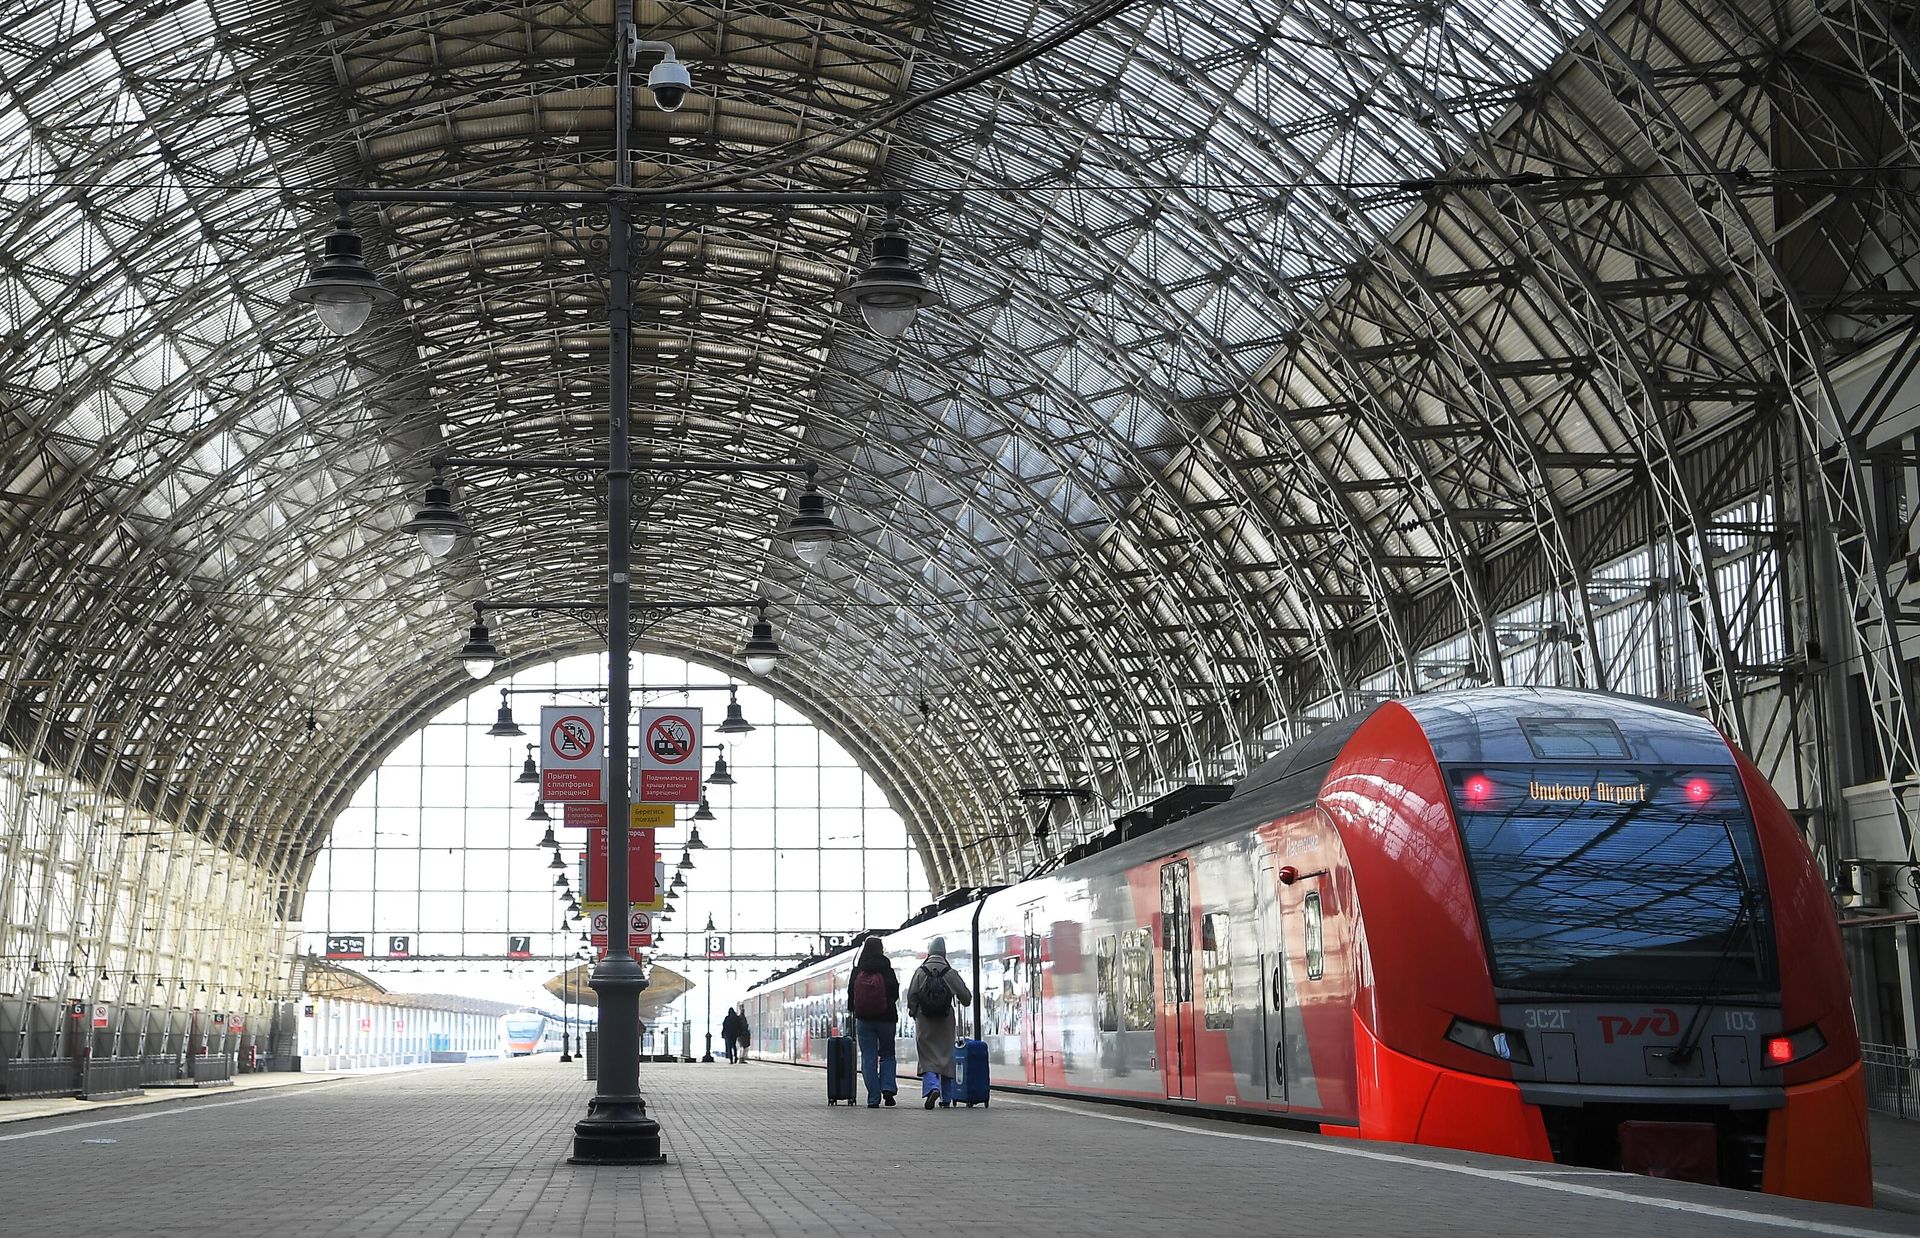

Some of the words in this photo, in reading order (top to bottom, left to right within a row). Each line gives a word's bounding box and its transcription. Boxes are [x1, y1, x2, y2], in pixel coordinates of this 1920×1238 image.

[547, 772, 577, 780] Прыгать
[1597, 782, 1646, 804] Airport
[635, 808, 664, 816] Берегись
[339, 939, 349, 953] 5
[393, 937, 404, 951] 6
[515, 937, 525, 951] 7
[709, 937, 720, 952] 8
[74, 1006, 82, 1014] 6
[1724, 1011, 1757, 1031] 103
